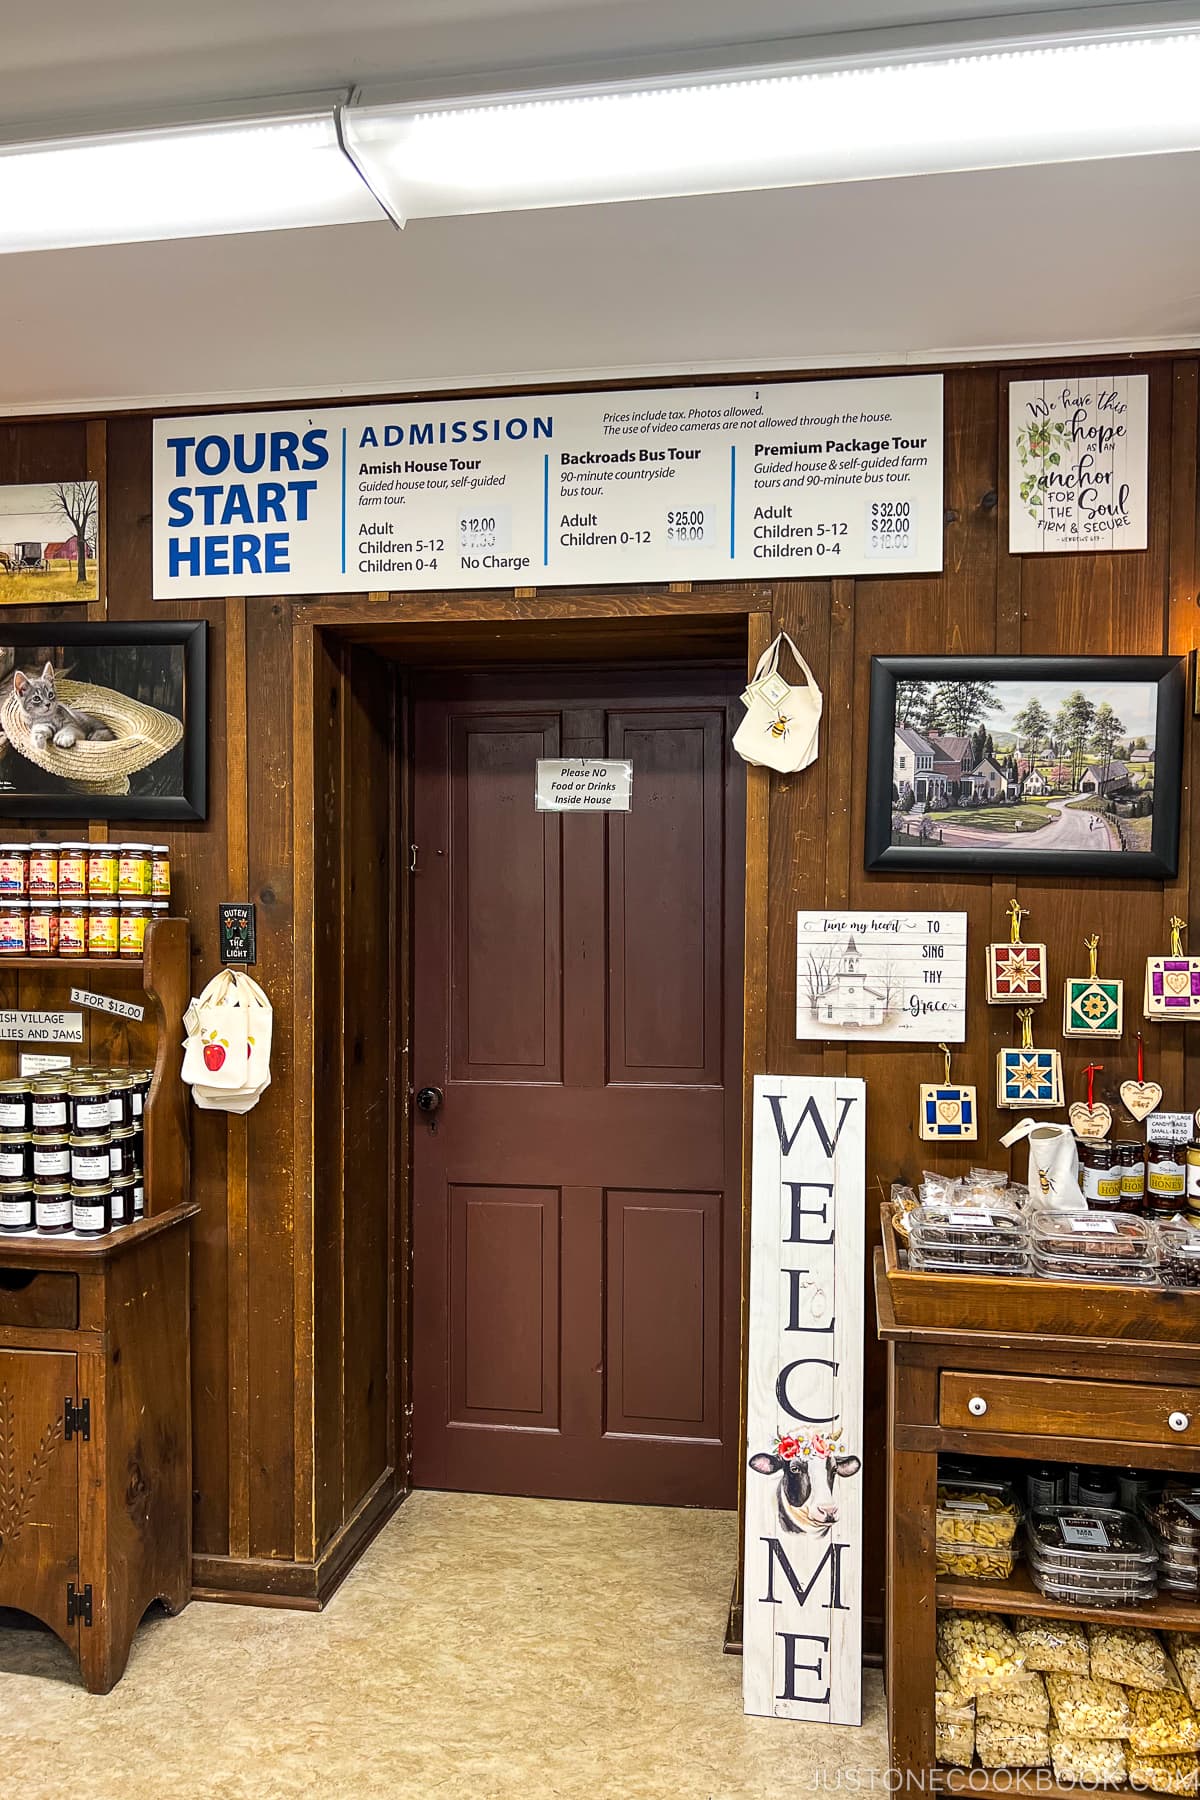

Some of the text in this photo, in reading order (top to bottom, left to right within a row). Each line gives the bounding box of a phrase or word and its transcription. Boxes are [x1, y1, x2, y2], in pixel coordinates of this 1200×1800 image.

[1026, 388, 1128, 418] We have this
[603, 406, 764, 422] Prices include tax. Photos allowed.
[604, 412, 892, 435] The use of video cameras are not allowed through the house.
[1065, 408, 1127, 453] hope
[359, 416, 553, 448] ADMISSION
[167, 428, 329, 477] TOURS
[754, 437, 928, 456] Premium Package Tour
[1086, 443, 1097, 452] AS
[560, 448, 702, 465] Backroads Bus Tour
[358, 458, 482, 475] Amish House Tour
[754, 456, 928, 474] Guided house & self-guided farm
[1038, 454, 1113, 488] anchor
[560, 467, 676, 482] 90-minute countryside
[754, 472, 911, 488] tours and 90-minute bus tour.
[358, 475, 506, 492] Guided house tour, self-guided
[560, 486, 604, 496] bus tour.
[167, 480, 318, 527] START
[358, 495, 406, 506] farm tour.
[1048, 490, 1074, 502] FOR
[1078, 484, 1130, 520] Soul
[754, 505, 792, 520] Adult
[872, 502, 910, 517] $32.00
[1048, 506, 1072, 519] THE
[460, 516, 496, 532] $12.00
[560, 513, 598, 527] Adult
[667, 510, 704, 526] $25.00
[872, 518, 910, 532] $22.00
[1038, 516, 1132, 534] FIRM & SECURE
[358, 522, 394, 536] Adult
[754, 522, 848, 538] Children 5-12
[560, 531, 652, 546] Children 0-12
[358, 539, 444, 554] Children 5-12
[754, 543, 841, 558] Children 0-4
[168, 532, 290, 577] HERE
[358, 555, 530, 572] Children 0-4 No Charge
[560, 768, 607, 778] Please NO
[552, 781, 616, 791] Food or Drinks
[555, 795, 612, 804] Inside House
[224, 909, 248, 918] OUTEN
[850, 922, 868, 934] my
[872, 918, 905, 933] heart
[927, 920, 940, 933] TO
[229, 939, 244, 947] THE
[922, 945, 944, 958] SING
[922, 970, 942, 984] THY
[74, 991, 141, 1018] 3 FOR $12.00
[909, 994, 950, 1017] Grace
[21, 1014, 65, 1024] VILLAGE
[28, 1029, 48, 1039] AND
[52, 1030, 82, 1040] JAMS
[1152, 1180, 1184, 1189] HONEY
